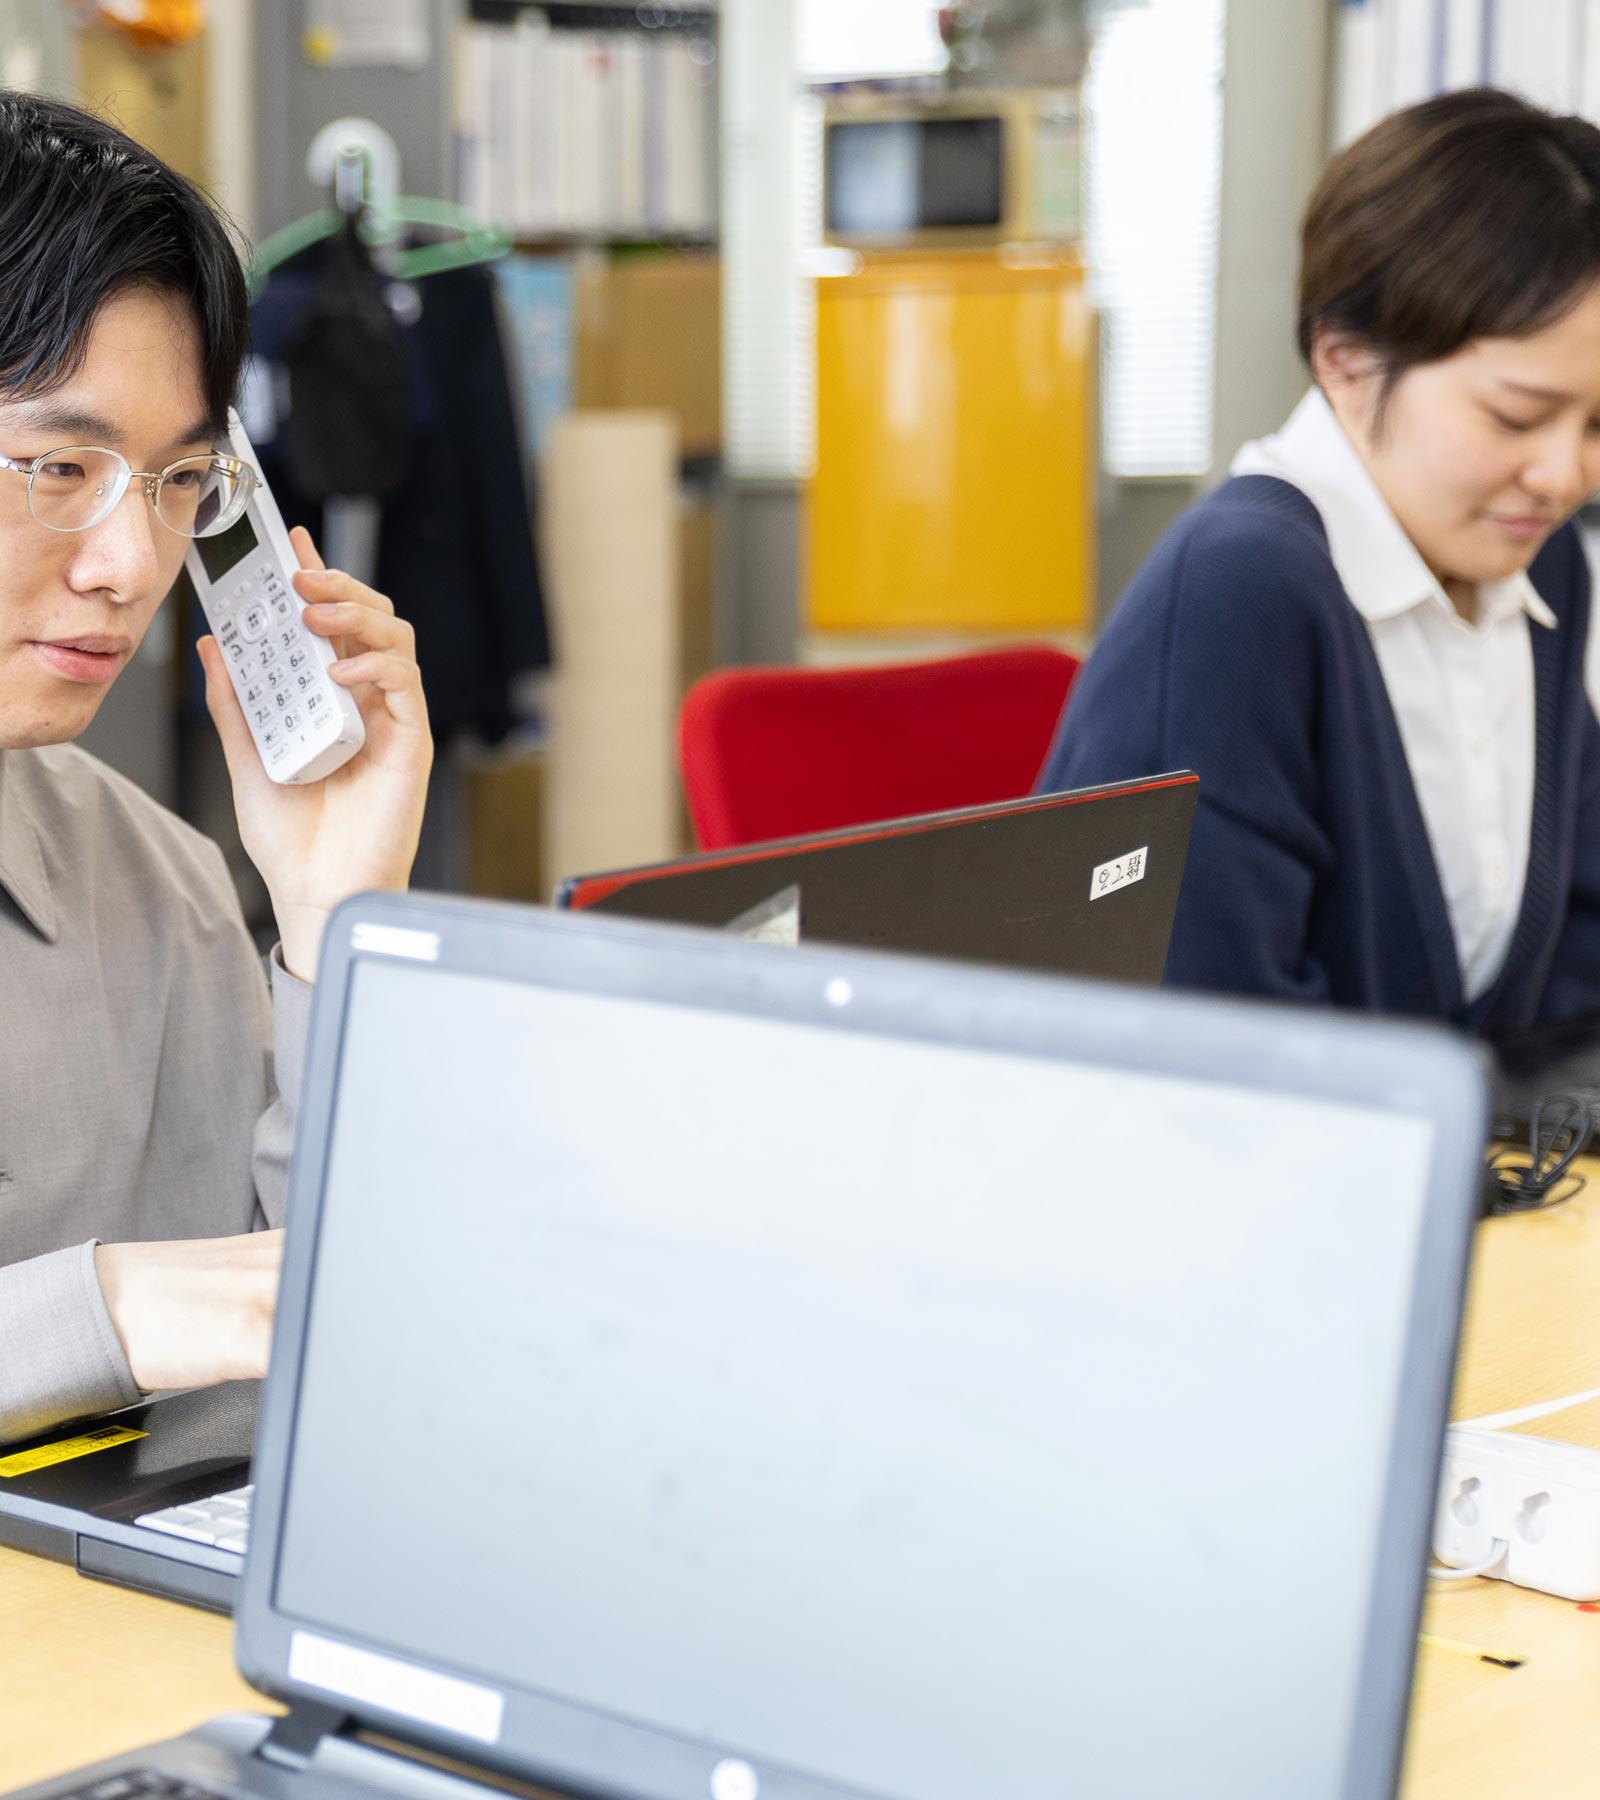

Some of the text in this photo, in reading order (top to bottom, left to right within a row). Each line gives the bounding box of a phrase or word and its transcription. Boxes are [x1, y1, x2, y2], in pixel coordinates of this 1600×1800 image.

[240, 668, 247, 680] 1
[260, 651, 269, 665] 2
[281, 633, 290, 647] 3
[247, 690, 255, 702] 4
[268, 672, 277, 686] 5
[289, 655, 298, 668] 6
[255, 710, 263, 724] 7
[276, 694, 285, 707] 8
[298, 676, 307, 689] 9
[285, 715, 294, 728] 0
